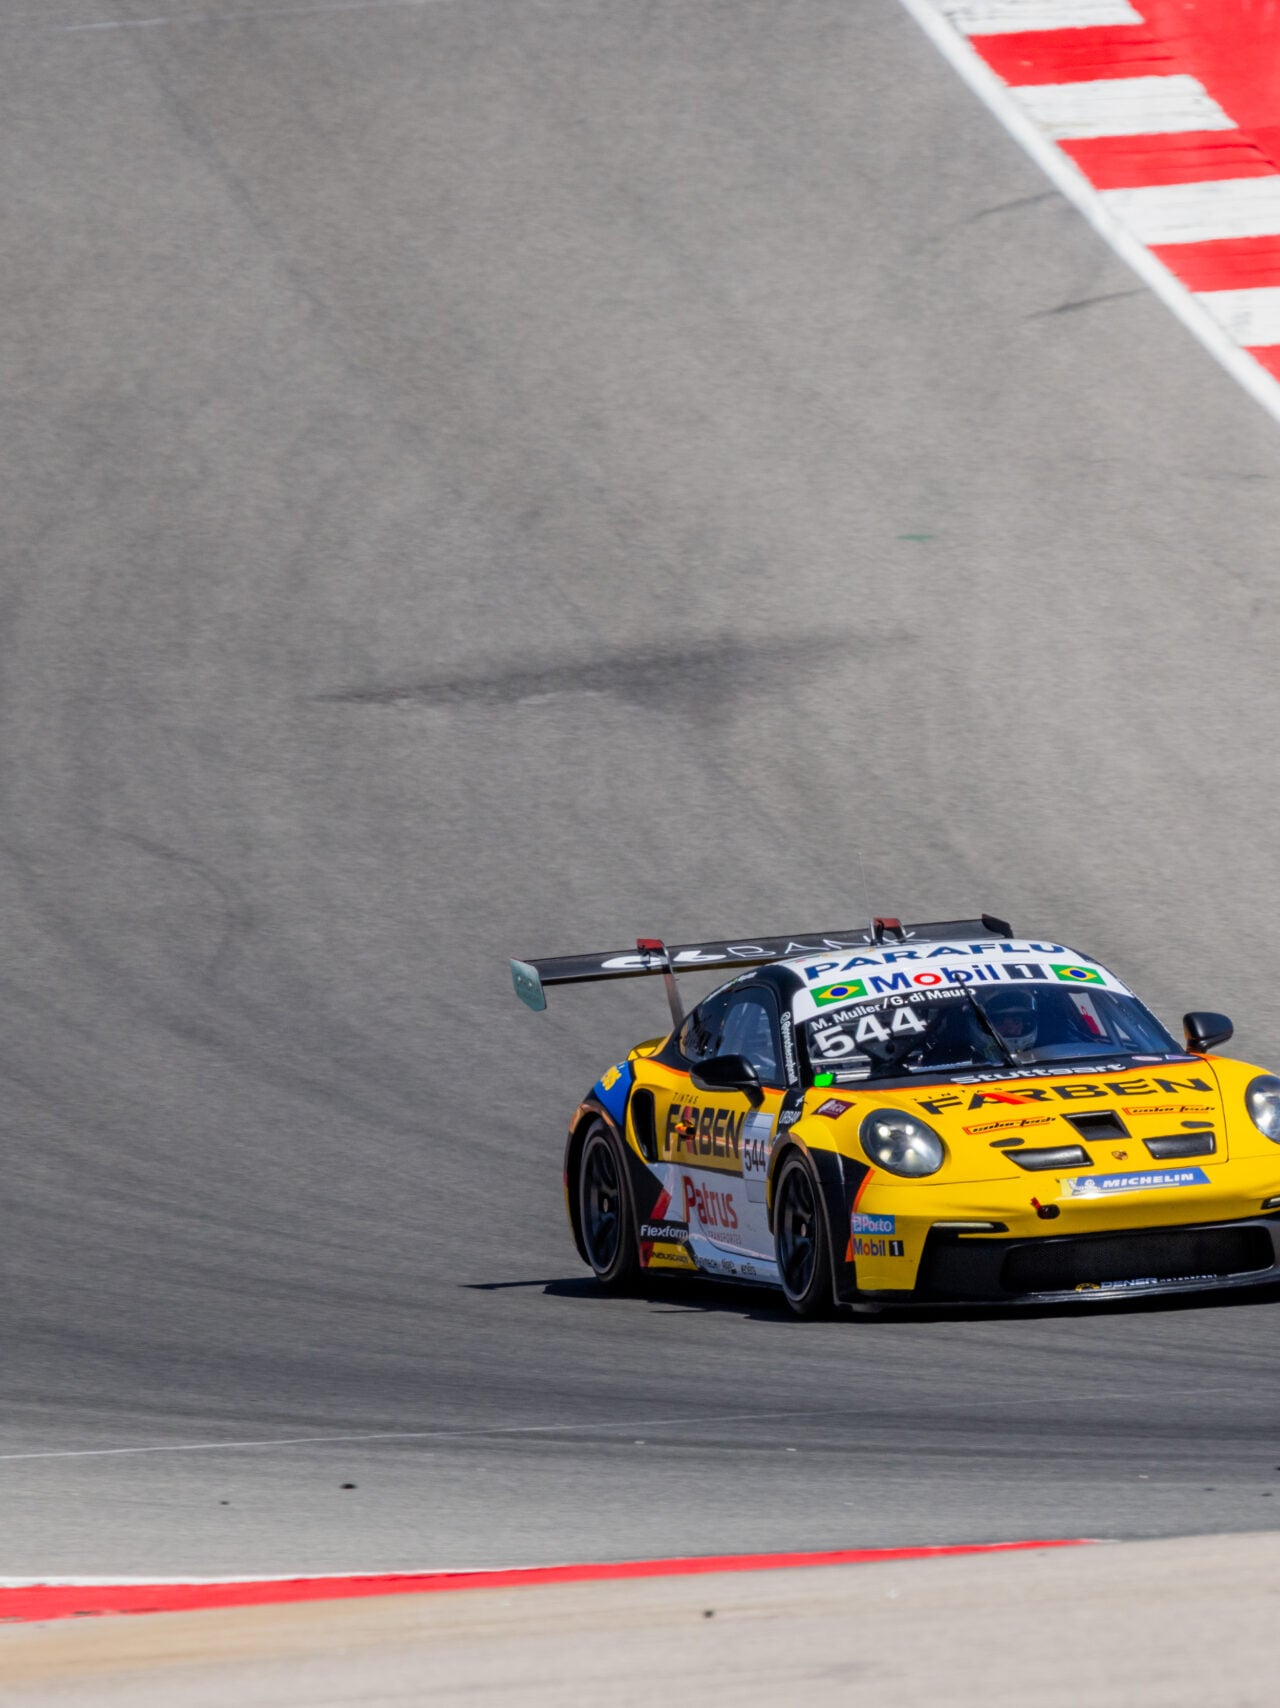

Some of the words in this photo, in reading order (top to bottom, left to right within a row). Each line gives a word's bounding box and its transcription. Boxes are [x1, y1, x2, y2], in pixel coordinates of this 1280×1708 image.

[803, 943, 1066, 981] PARAFLU
[868, 963, 1000, 994] Mobil
[1014, 965, 1028, 979] 1
[811, 1016, 833, 1032] M.
[911, 991, 924, 1002] di
[925, 988, 976, 1000] Mauro
[813, 1006, 928, 1058] 544
[950, 1062, 1127, 1085] Stuttgart
[672, 1092, 699, 1104] TINTAS
[916, 1077, 1214, 1115] FARBEN
[664, 1103, 745, 1160] FARBEN
[744, 1138, 766, 1172] 544
[1102, 1173, 1194, 1189] MICHELIN
[682, 1175, 738, 1229] Patrus
[640, 1225, 689, 1239] Flexform
[862, 1215, 893, 1232] Porto
[853, 1238, 886, 1256] Mobil
[1101, 1277, 1158, 1290] DENER
